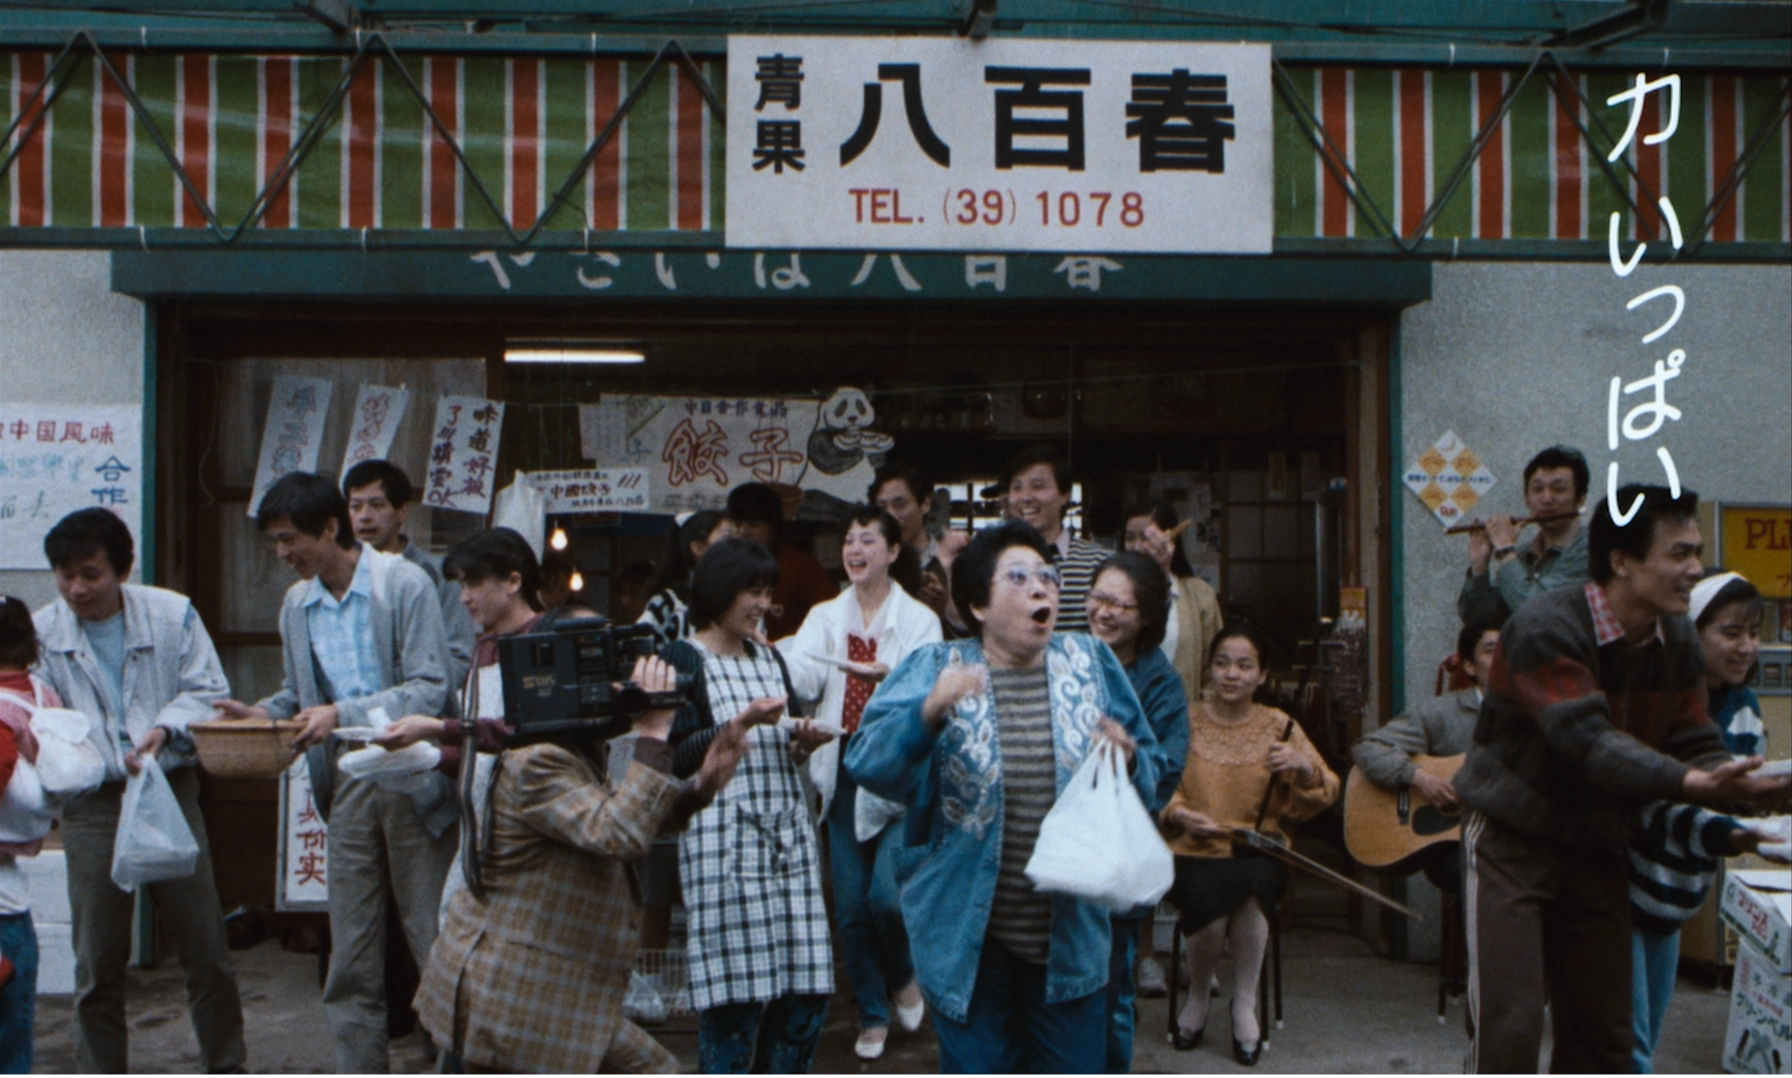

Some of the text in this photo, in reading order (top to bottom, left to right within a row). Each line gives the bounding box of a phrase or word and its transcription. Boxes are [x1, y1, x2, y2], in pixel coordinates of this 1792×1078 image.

[752, 52, 806, 175] 青果
[839, 62, 1236, 174] 八百春
[848, 187, 1146, 228] TEL. (39) 1078
[91, 455, 131, 504] 合作
[1744, 517, 1791, 550] PL
